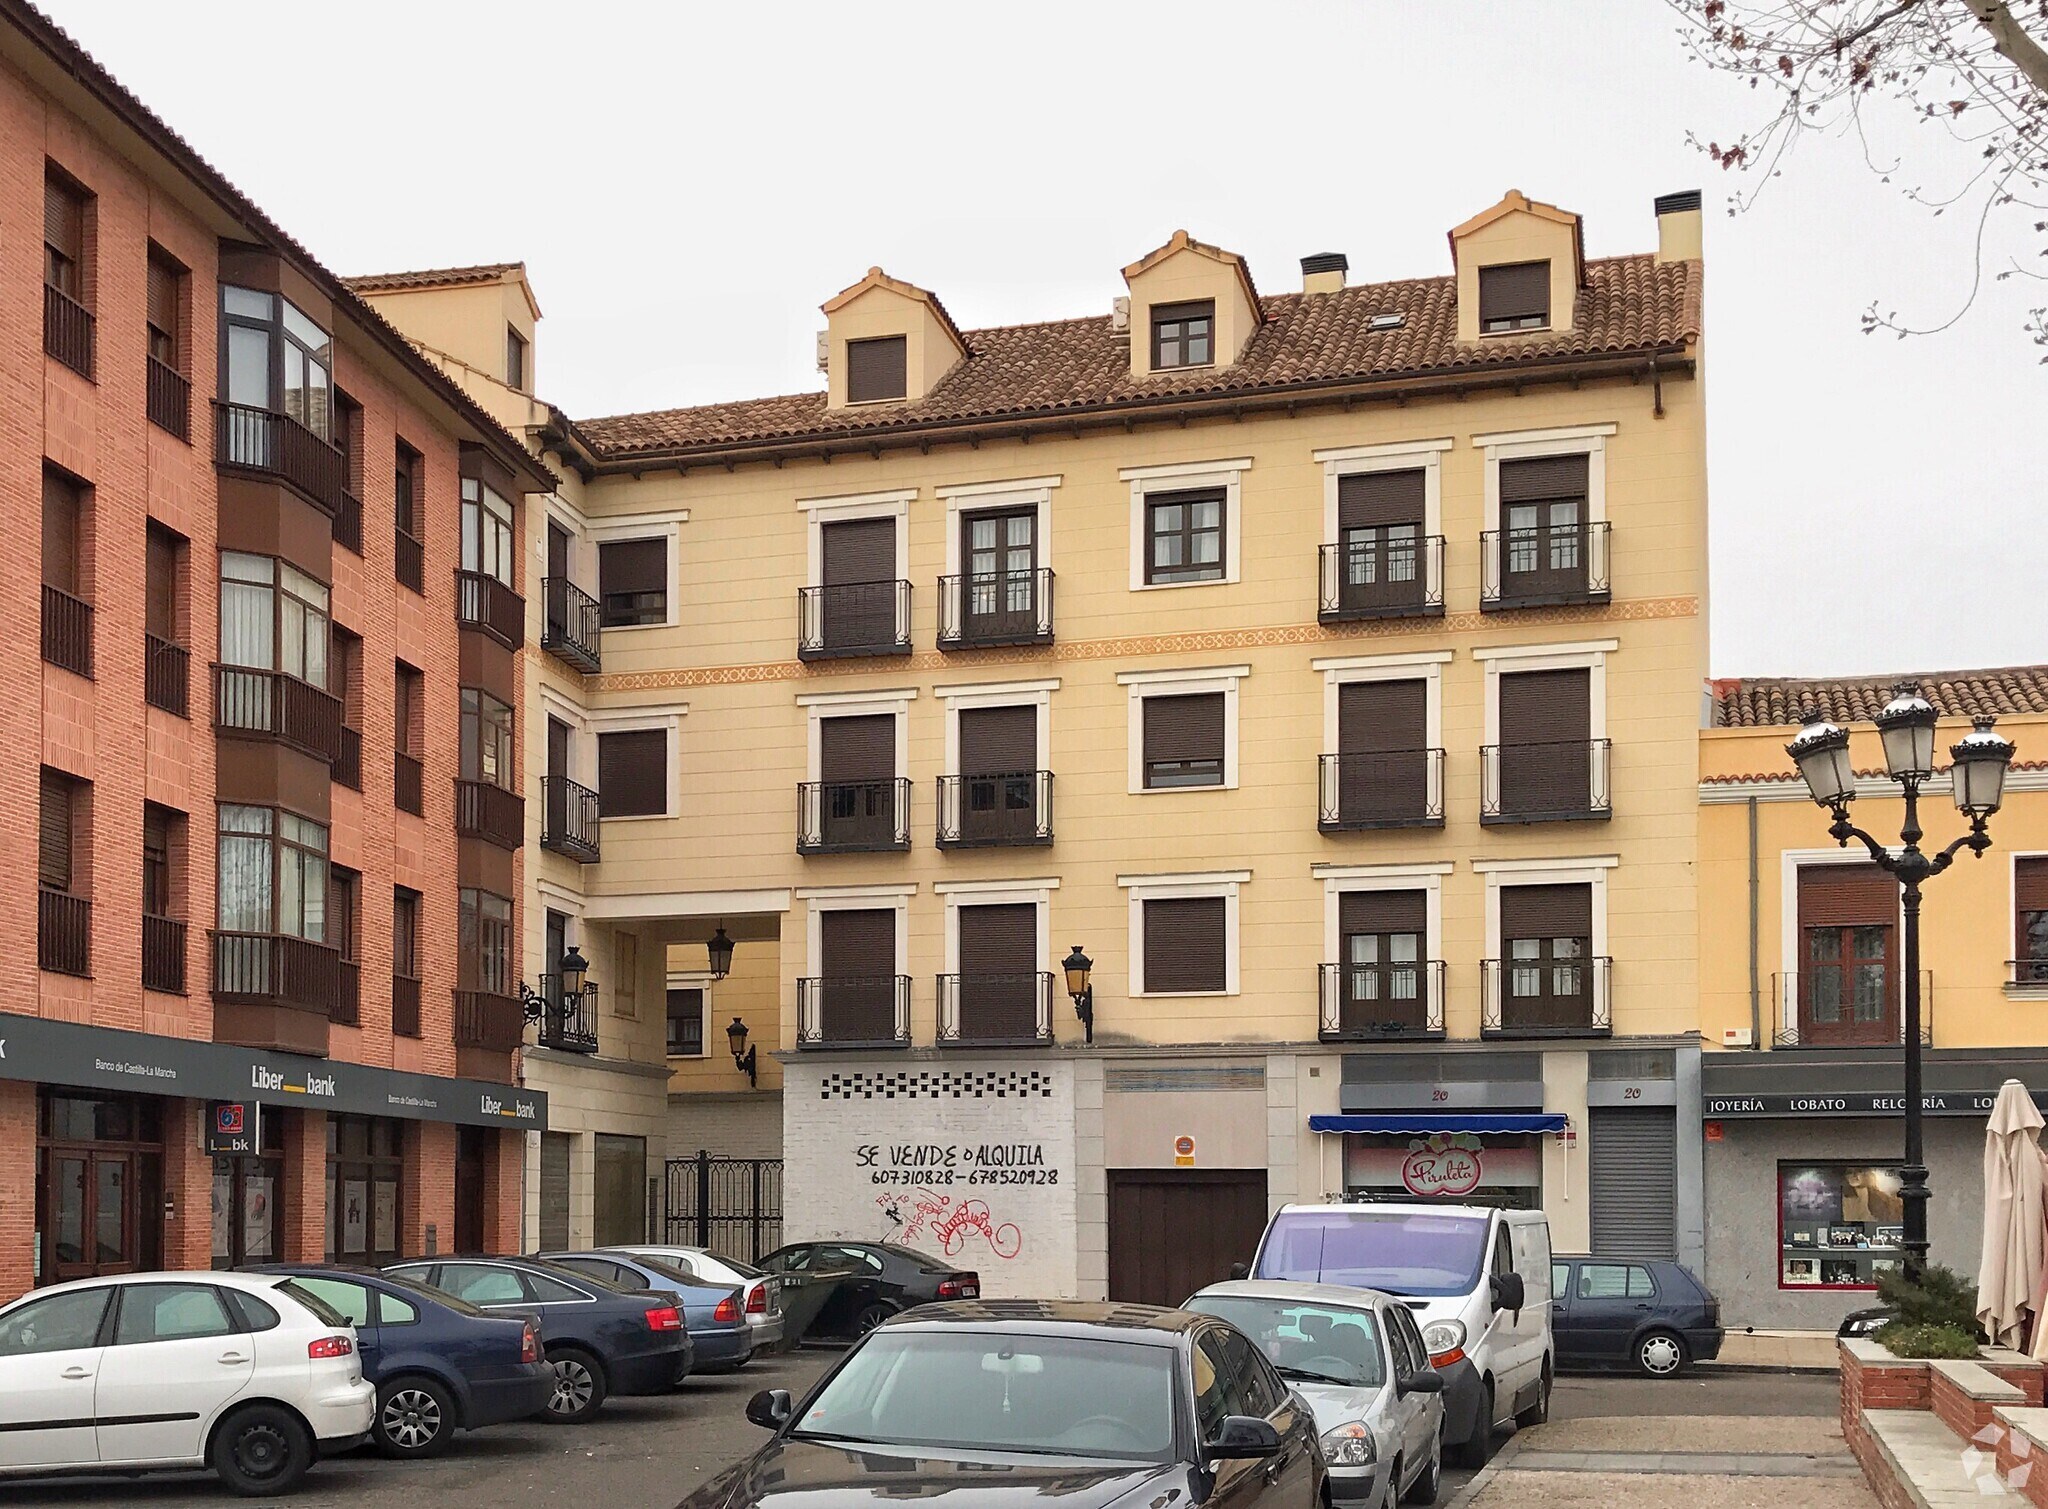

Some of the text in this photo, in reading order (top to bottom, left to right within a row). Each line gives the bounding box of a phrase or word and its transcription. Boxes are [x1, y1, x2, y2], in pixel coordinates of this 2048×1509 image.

[95, 1058, 115, 1071] Banco
[115, 1062, 124, 1072] de
[154, 1066, 177, 1078] Mancha
[1432, 1089, 1449, 1101] 20
[1624, 1087, 1641, 1099] 20
[1710, 1097, 1765, 1112] JOYERÍA
[1790, 1099, 1846, 1111] LOBATO
[856, 1145, 880, 1167] SE
[890, 1145, 957, 1167] VENDE
[974, 1144, 1044, 1167] ALQUILA
[1411, 1160, 1473, 1184] Piruleta
